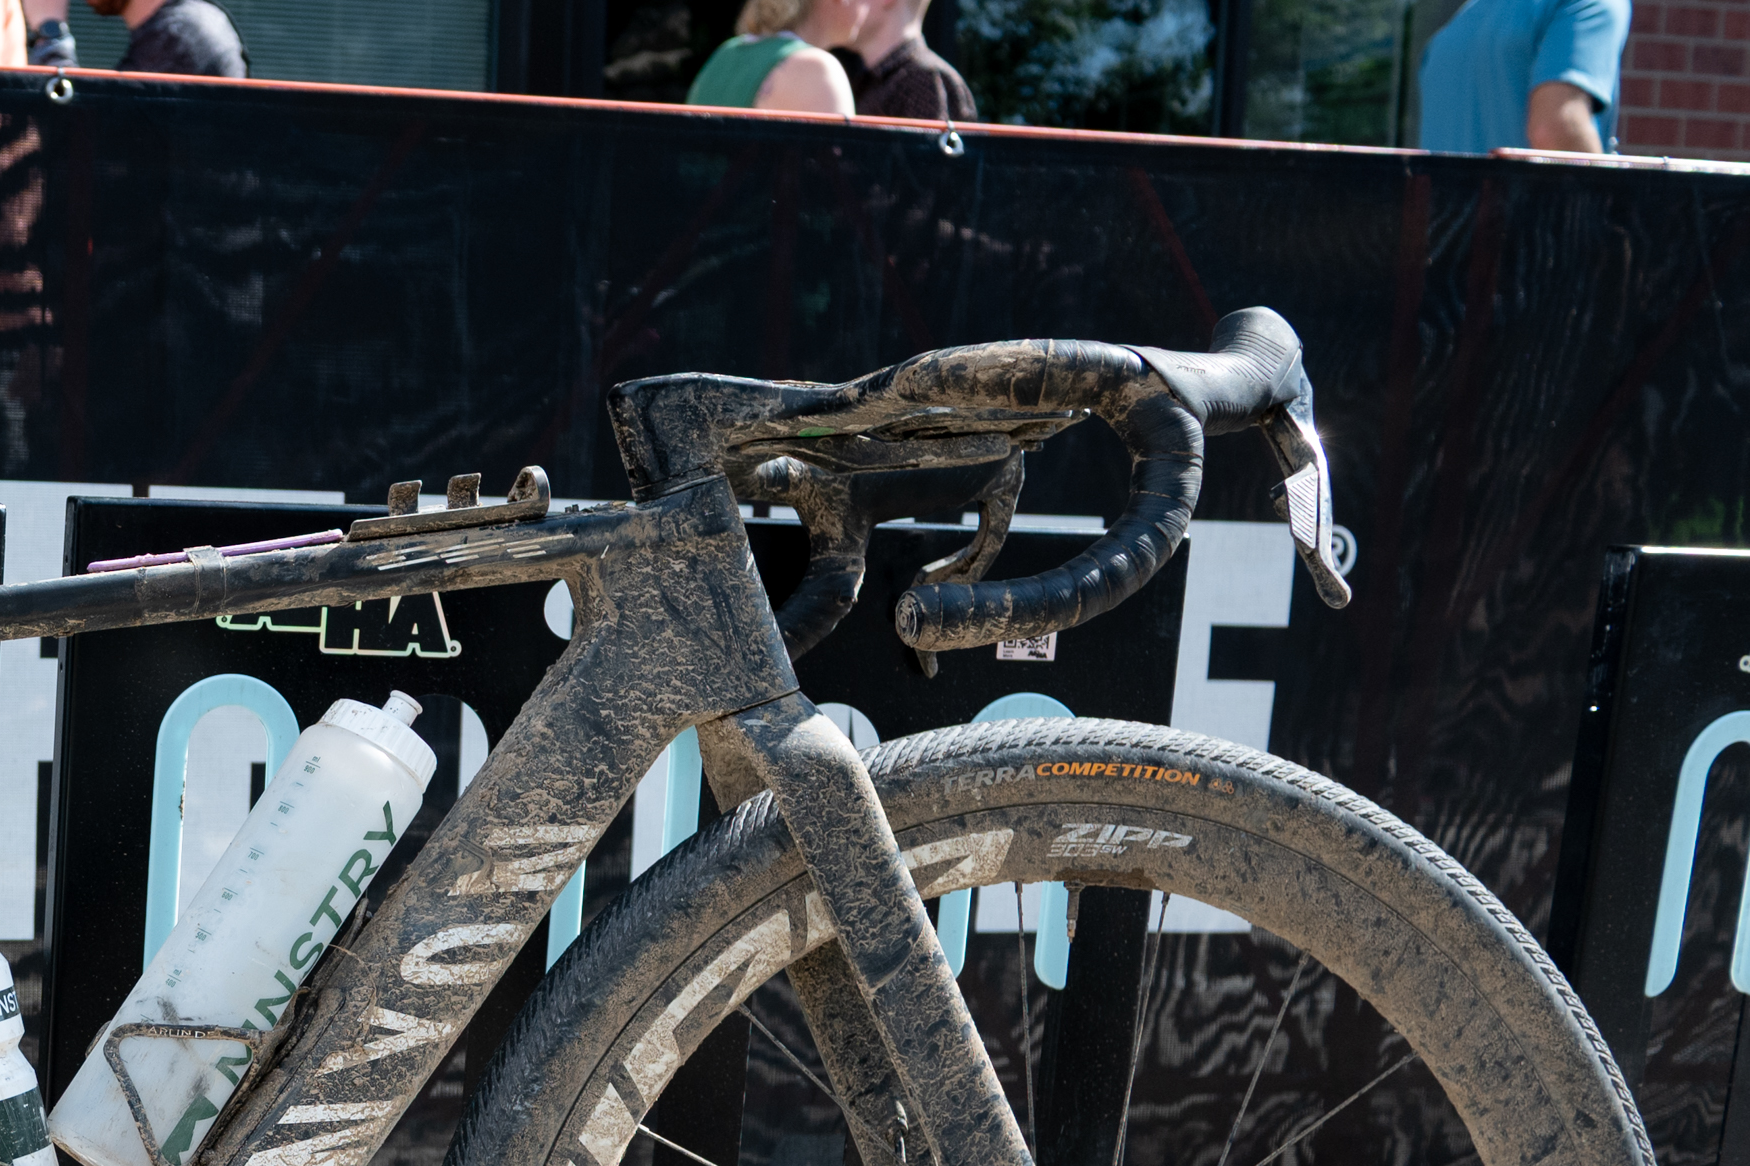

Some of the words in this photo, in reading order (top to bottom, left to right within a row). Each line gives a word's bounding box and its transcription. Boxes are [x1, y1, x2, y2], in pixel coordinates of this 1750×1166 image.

[941, 763, 1037, 796] TERRA
[1036, 761, 1202, 787] COMPETITION
[1052, 822, 1194, 849] ZIPP
[247, 851, 260, 861] 700
[195, 931, 208, 942] 500
